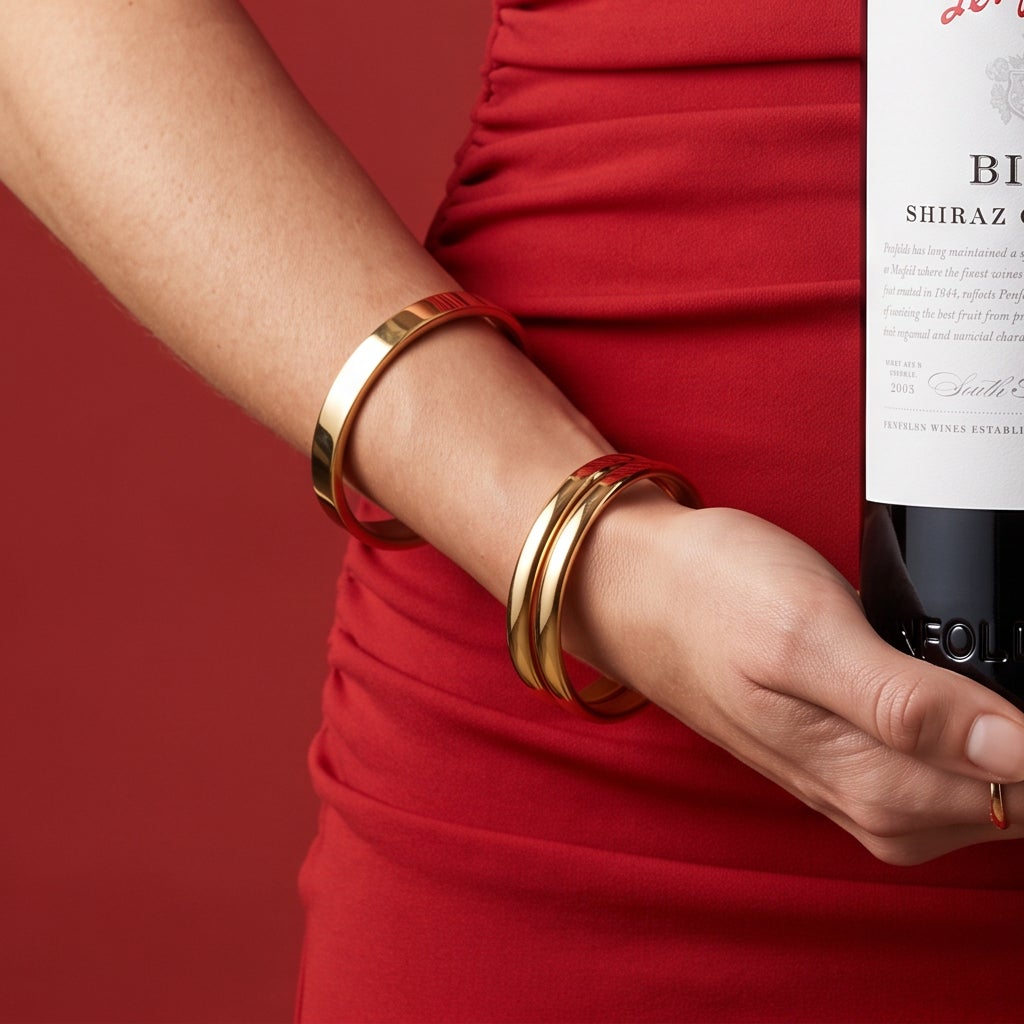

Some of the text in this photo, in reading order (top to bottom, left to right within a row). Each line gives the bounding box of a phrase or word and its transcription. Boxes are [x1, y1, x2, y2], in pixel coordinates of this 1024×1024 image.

[905, 205, 1007, 226] SHIRAZ
[912, 244, 926, 255] has
[949, 247, 1008, 258] maintained
[917, 266, 943, 277] where
[944, 267, 959, 278] the
[923, 287, 932, 297] in
[921, 308, 936, 319] the
[937, 308, 955, 320] best
[956, 309, 982, 323] fruit
[981, 309, 1010, 324] from
[932, 330, 951, 340] and
[927, 371, 1014, 398] South
[930, 423, 967, 434] WINES
